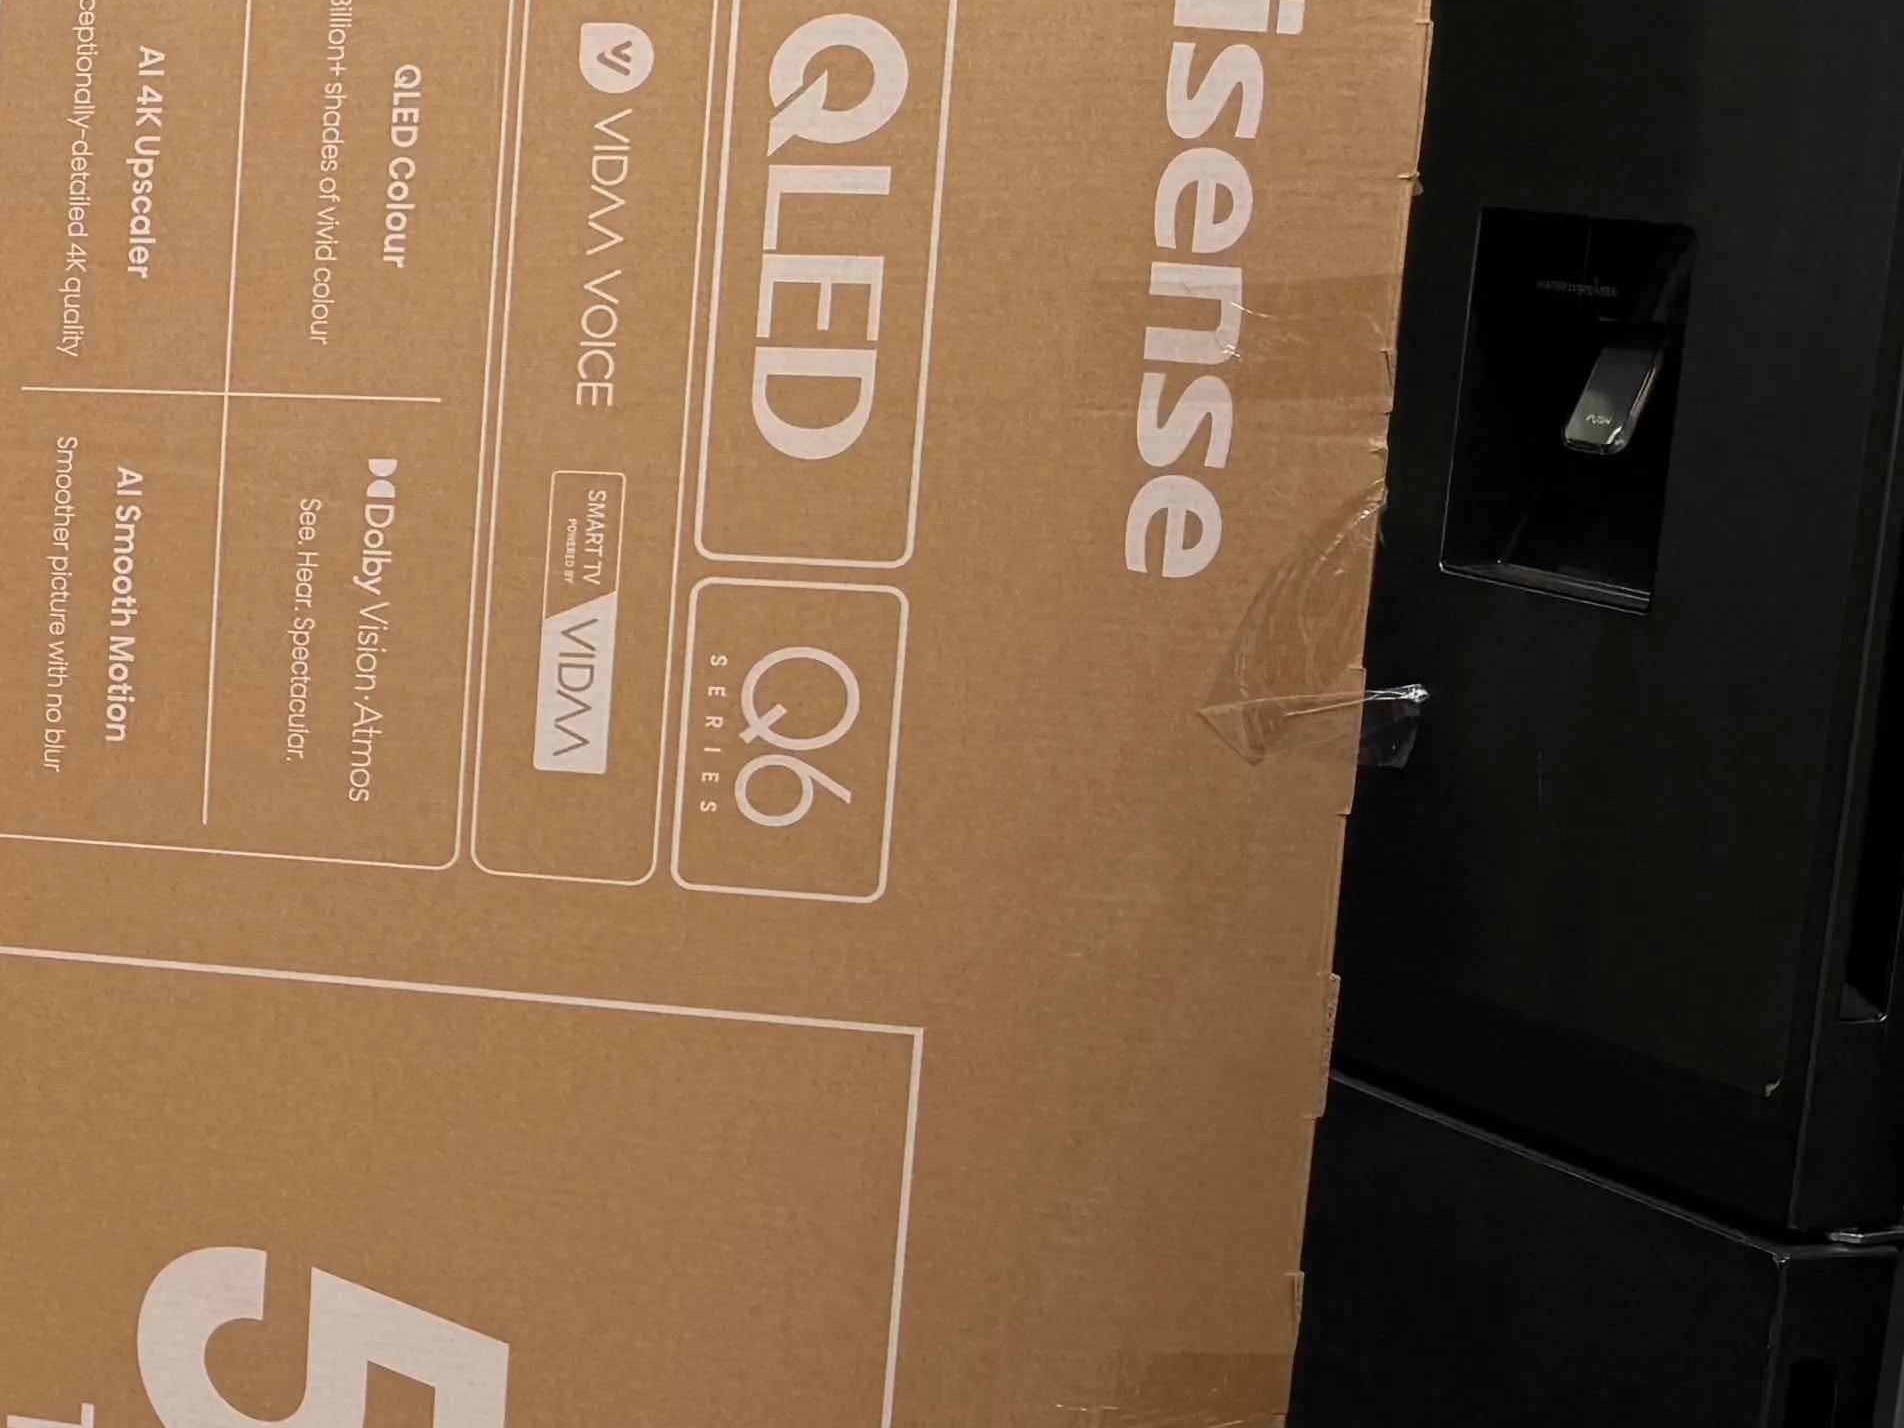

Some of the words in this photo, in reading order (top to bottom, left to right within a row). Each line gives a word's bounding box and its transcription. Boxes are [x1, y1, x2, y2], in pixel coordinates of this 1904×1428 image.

[137, 45, 166, 76] AI
[135, 85, 164, 128] 4K
[320, 82, 348, 172] shades
[391, 64, 421, 148] QLED
[126, 135, 162, 278] Upscaler
[319, 177, 342, 202] of
[383, 156, 415, 268] Colour
[585, 109, 634, 257] VIDAA
[66, 243, 88, 271] 4K
[315, 206, 340, 261] vivid
[750, 11, 909, 463] QLED
[56, 277, 85, 357] quality
[309, 267, 335, 345] colour
[575, 268, 623, 410] VOICE
[52, 436, 78, 550] Smoother
[116, 466, 144, 496] AI
[297, 498, 322, 545] See.
[352, 503, 396, 595] Dolby
[584, 489, 607, 557] SMART
[47, 556, 73, 636] picture
[110, 505, 142, 627] Smooth
[293, 552, 319, 612] Hear.
[582, 562, 602, 585] TV
[47, 641, 70, 687] with
[104, 635, 137, 742] Motion
[285, 617, 315, 762] Spectacular.
[45, 694, 66, 723] no
[699, 649, 729, 816] SERIES
[733, 644, 861, 829] Q6
[43, 728, 67, 773] blur
